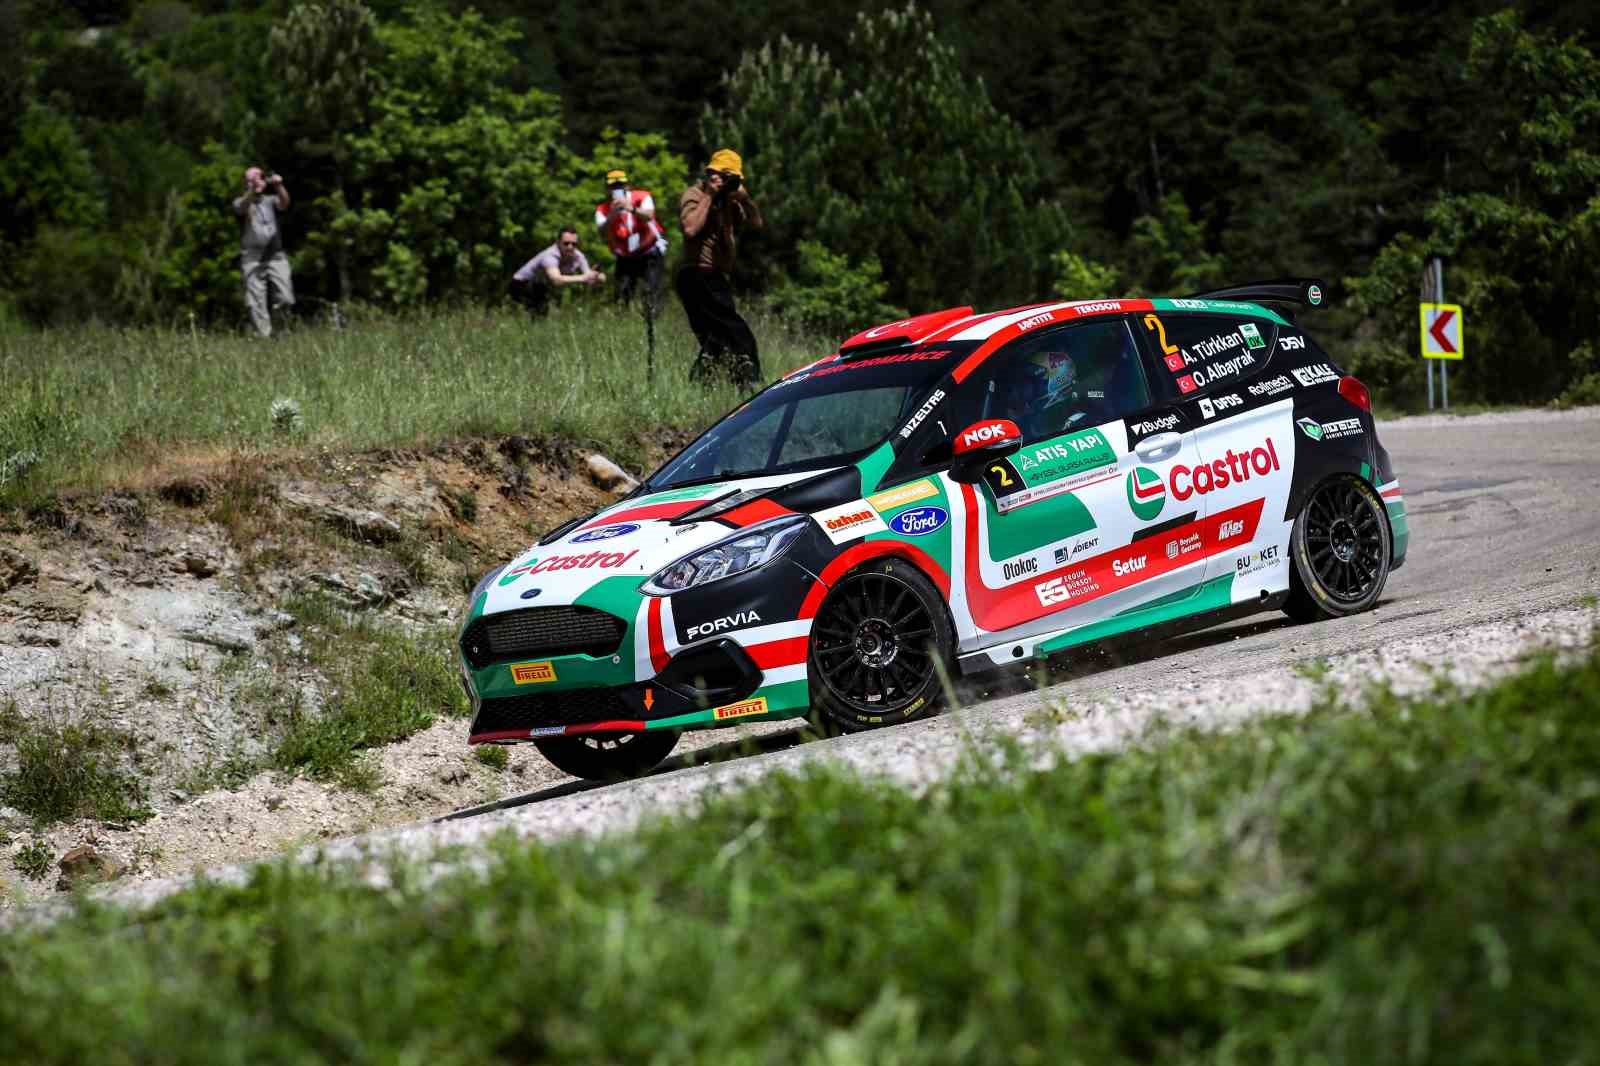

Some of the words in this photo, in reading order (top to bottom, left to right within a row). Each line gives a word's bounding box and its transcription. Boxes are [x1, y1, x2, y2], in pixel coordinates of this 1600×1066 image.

[1143, 314, 1180, 355] 2
[1279, 336, 1305, 351] DSV
[1181, 349, 1198, 366] A.
[1192, 332, 1244, 360] Türkkan
[1213, 393, 1244, 410] DFDS
[964, 424, 1006, 446] NGK
[1143, 414, 1181, 434] Budget
[1067, 434, 1103, 452] YAPI
[991, 465, 1014, 487] 2
[1170, 437, 1280, 502] Castrol
[825, 510, 875, 530] özhan
[901, 510, 938, 533] Ford
[530, 550, 640, 575] Castrol
[1003, 557, 1038, 580] Otokoç
[1112, 555, 1148, 577] Setur
[686, 610, 761, 640] FORVIA
[515, 665, 552, 681] PIRELLI
[716, 700, 763, 718] PIRELLI
